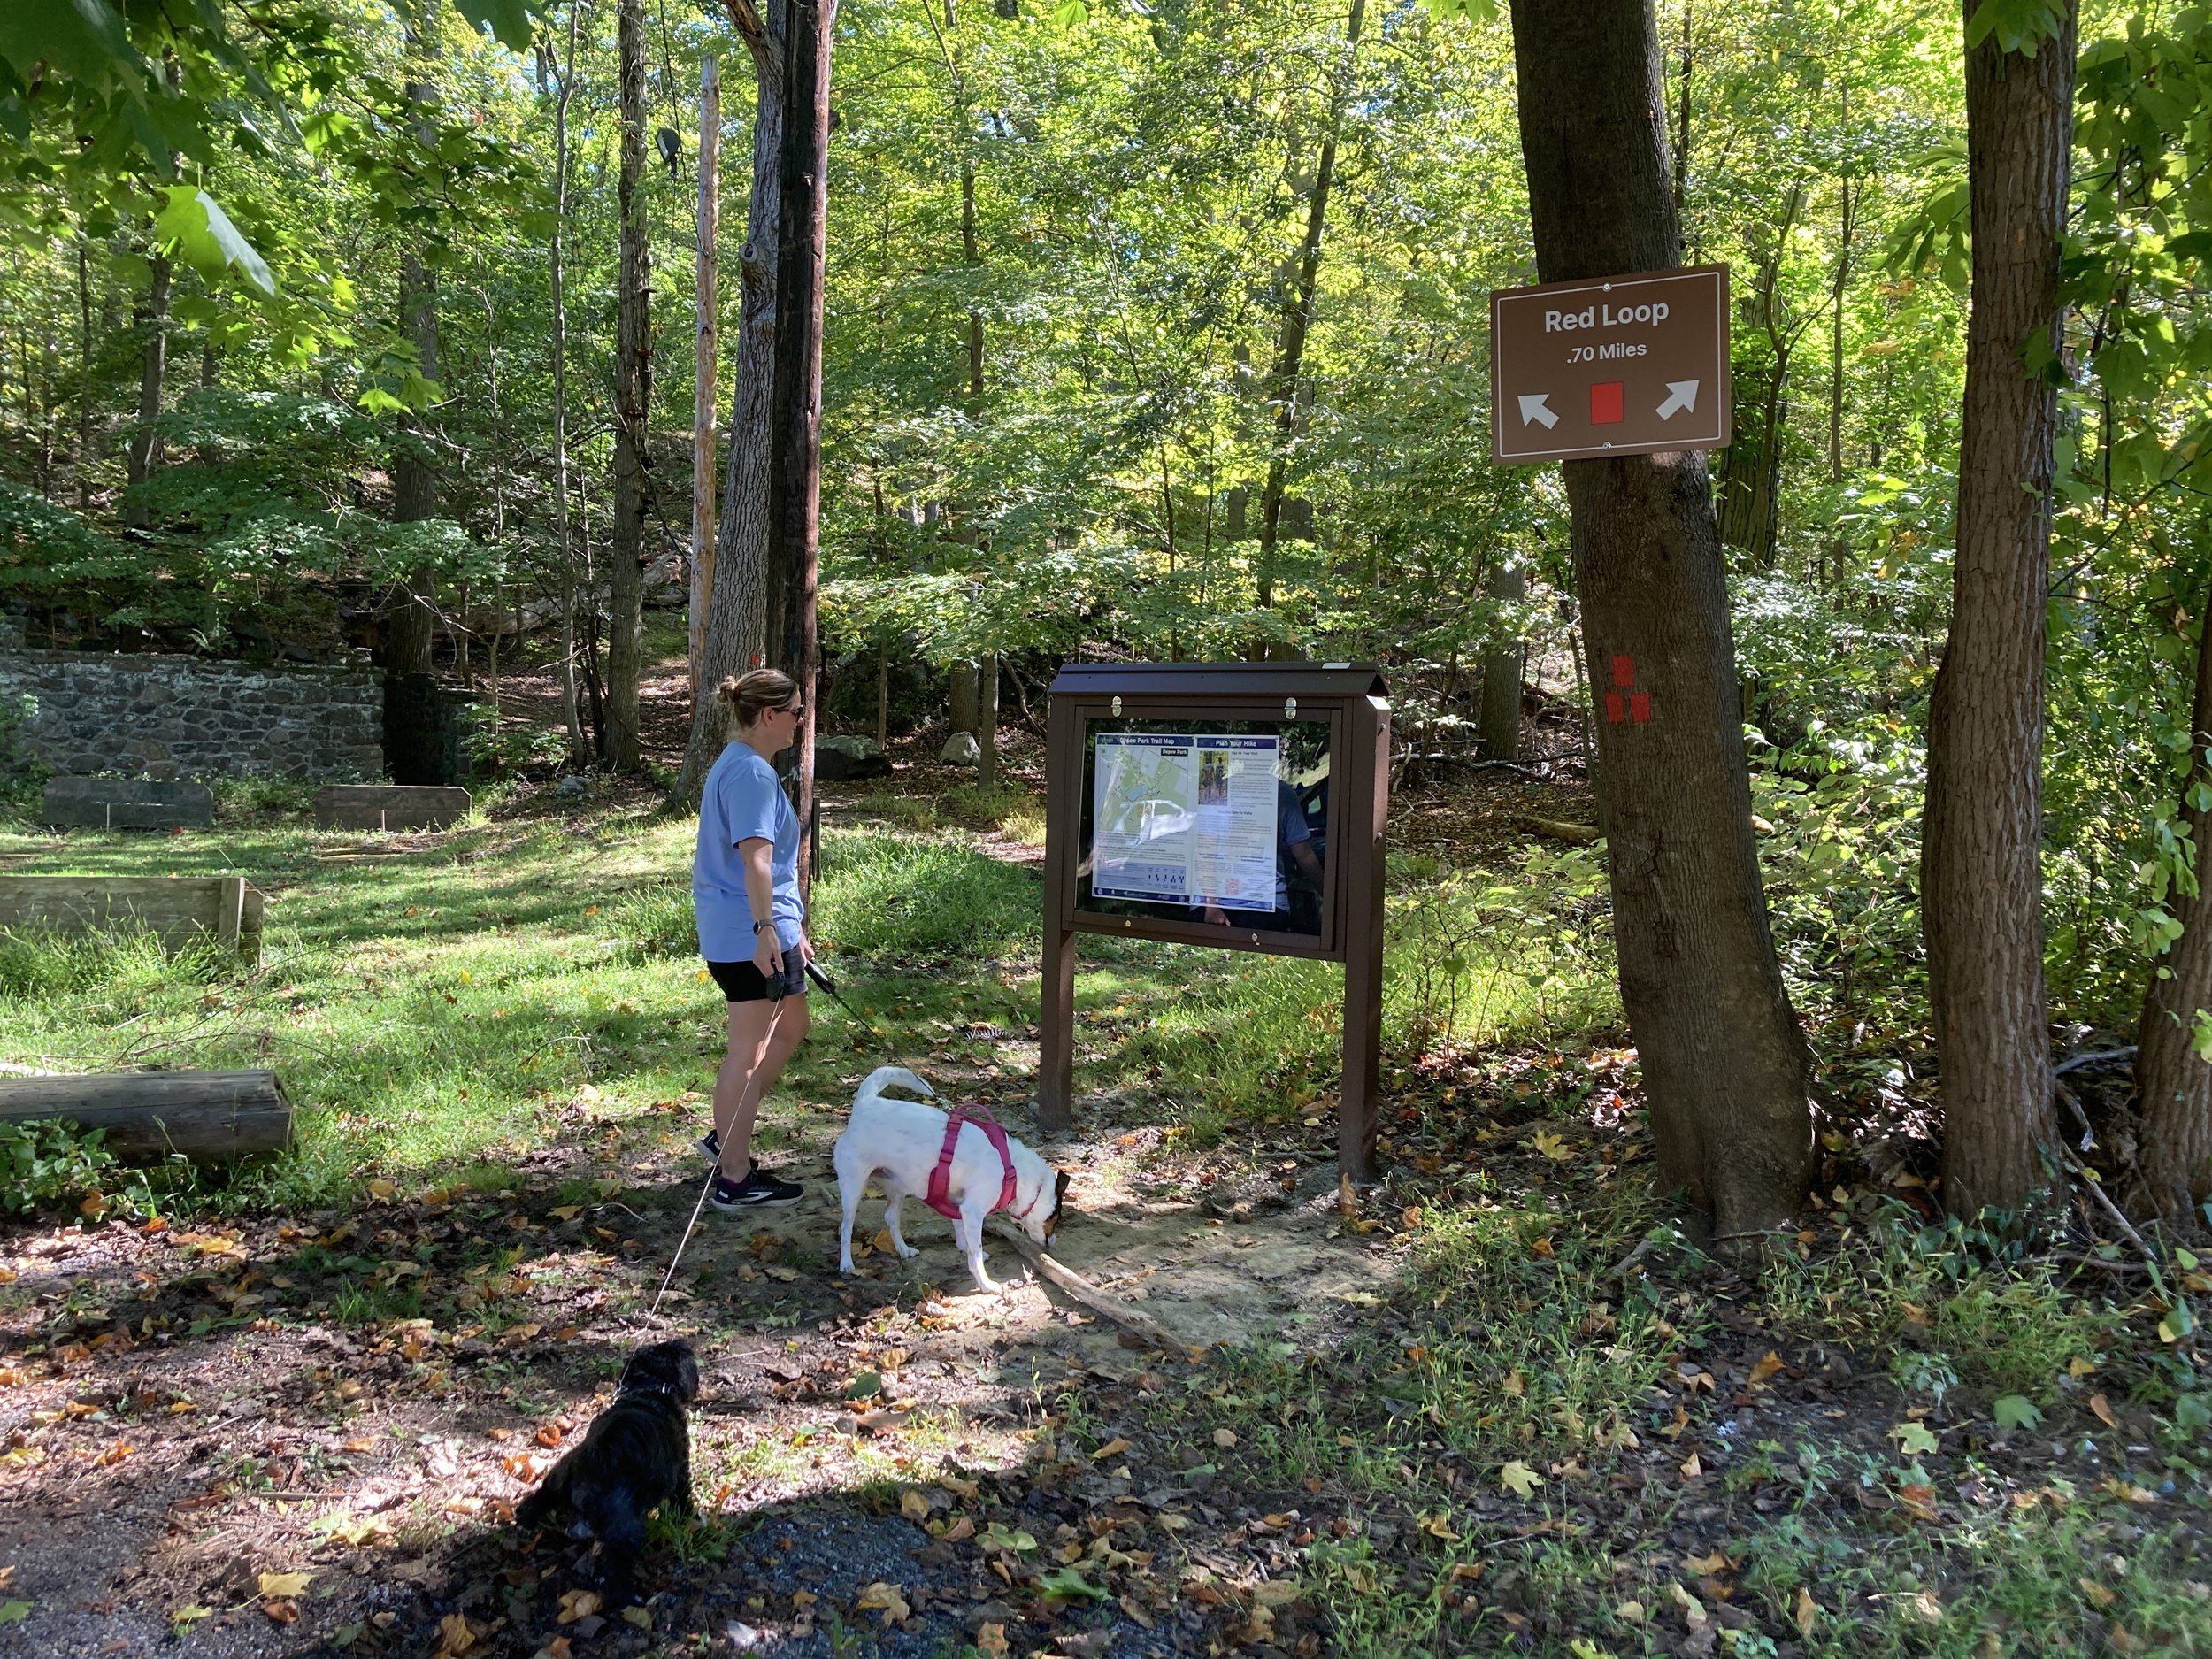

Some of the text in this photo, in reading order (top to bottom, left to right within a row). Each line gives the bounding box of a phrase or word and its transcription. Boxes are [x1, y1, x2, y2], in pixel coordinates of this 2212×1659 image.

[1545, 303, 1670, 333] Red Loop
[1566, 342, 1647, 364] .70 Miles
